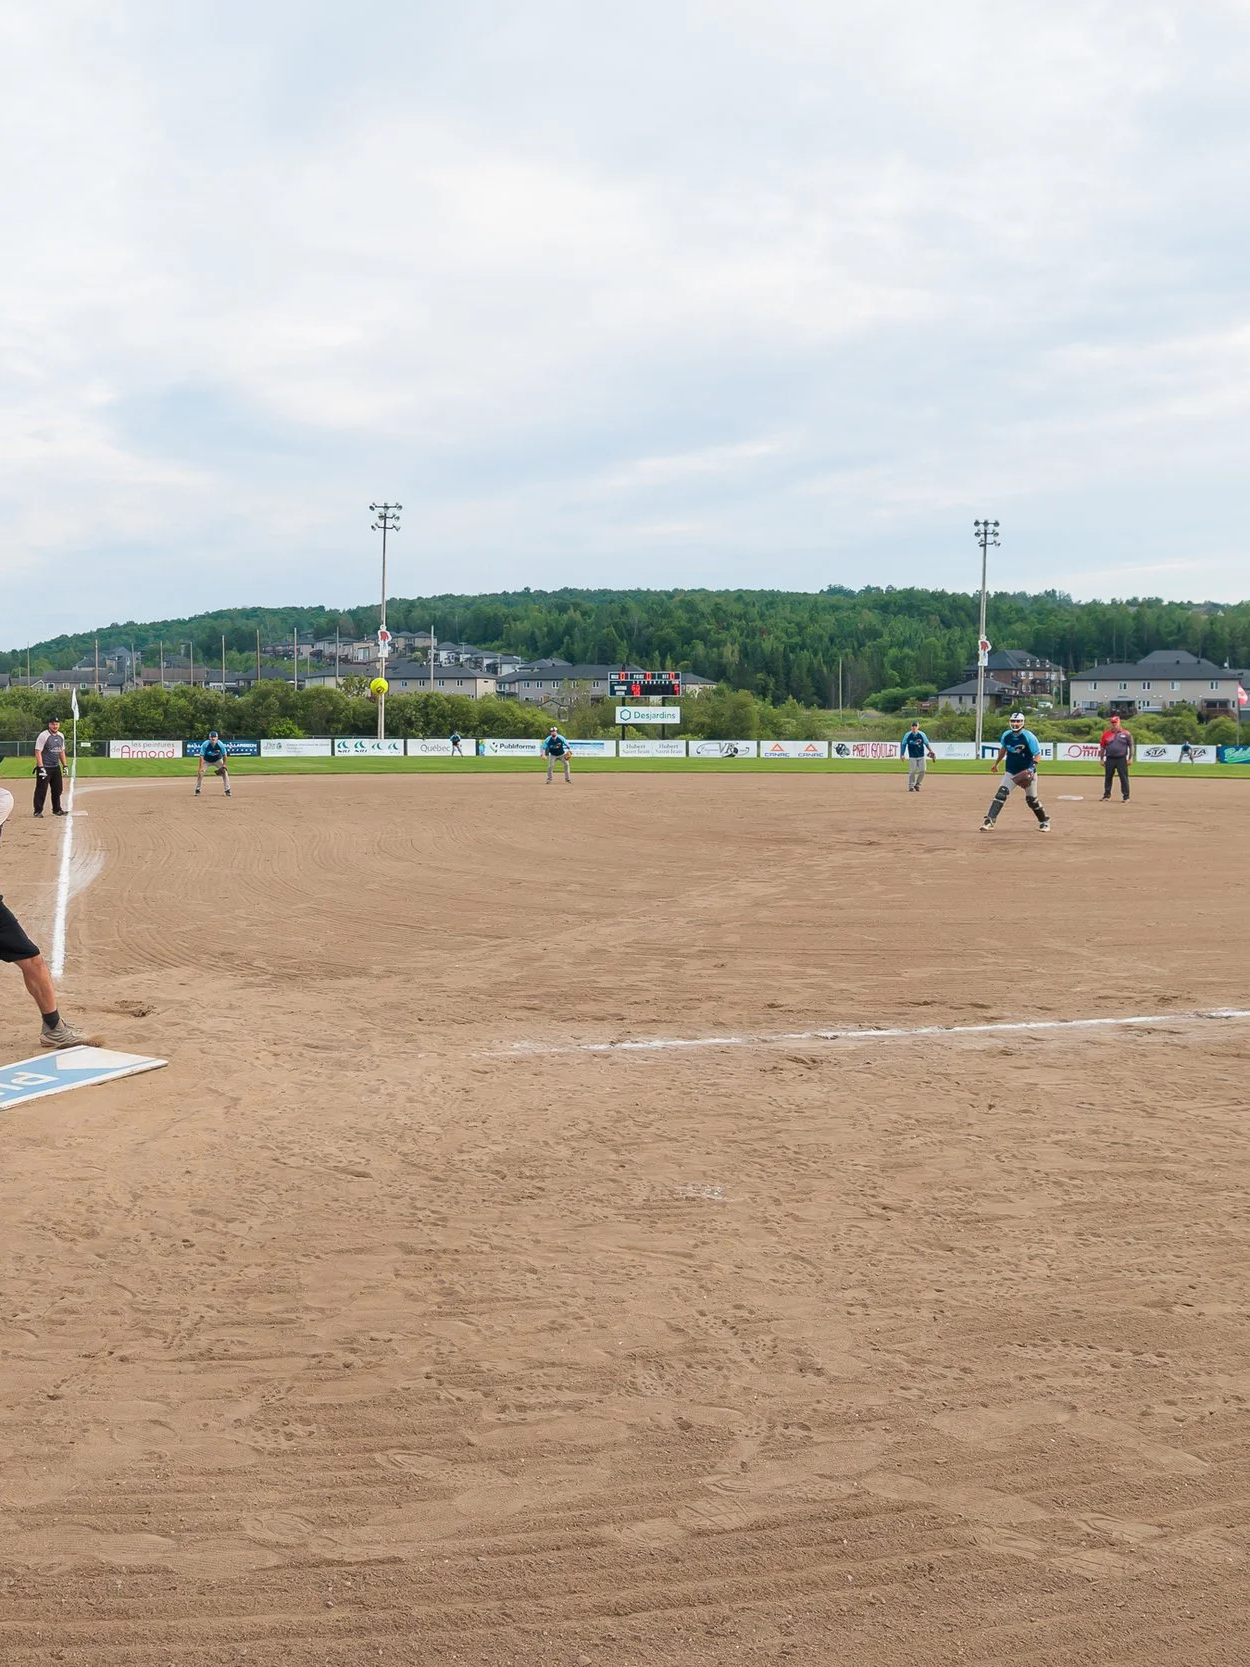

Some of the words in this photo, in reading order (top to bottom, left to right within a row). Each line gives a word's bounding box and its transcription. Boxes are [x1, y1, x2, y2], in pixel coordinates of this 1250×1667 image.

[633, 711, 676, 720] Desjardins
[143, 741, 175, 749] peintures
[420, 744, 450, 753] Québec
[121, 745, 175, 758] Armond
[852, 744, 870, 758] PNEU
[871, 742, 899, 758] GOULET
